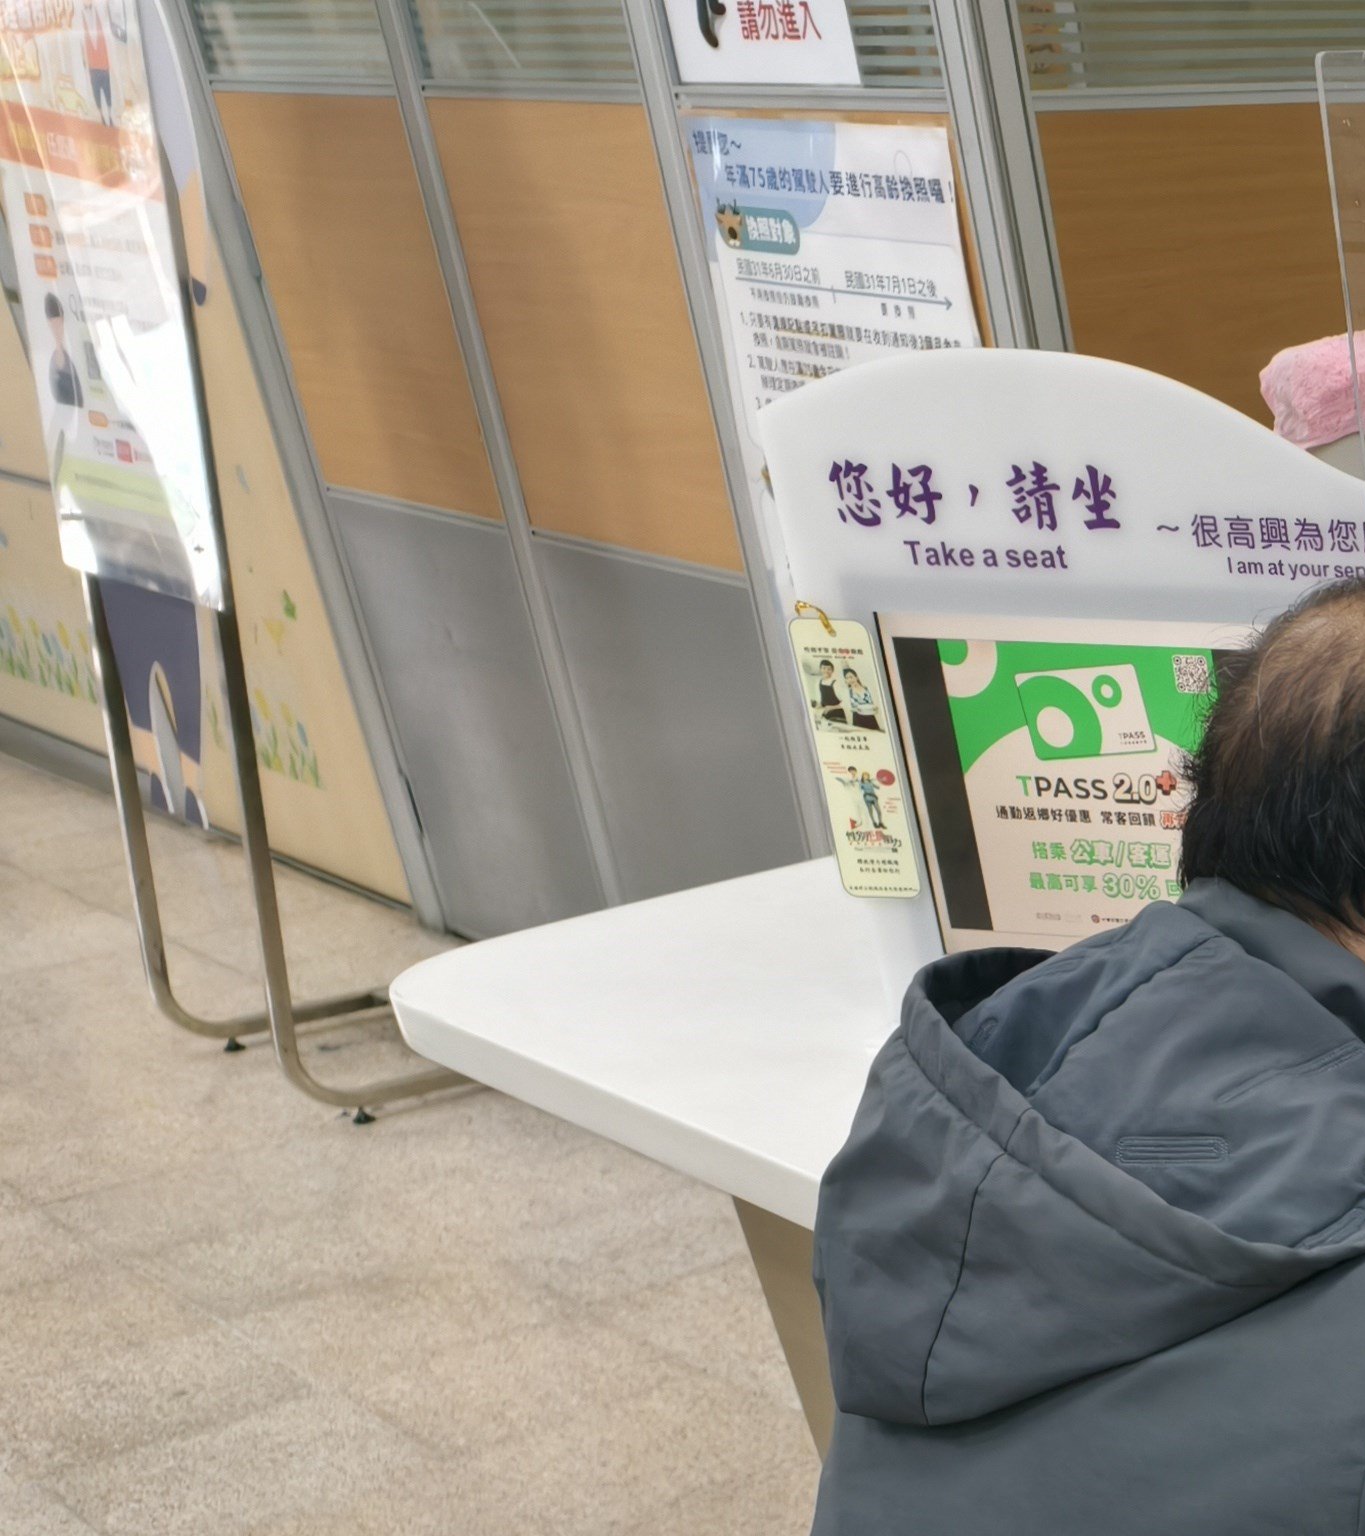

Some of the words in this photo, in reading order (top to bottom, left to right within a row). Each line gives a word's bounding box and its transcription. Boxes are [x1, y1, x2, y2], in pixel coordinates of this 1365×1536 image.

[737, 1, 822, 41] 請勿進入
[828, 459, 1121, 532] 您好，請坐
[904, 540, 974, 568] Take
[983, 547, 999, 568] a
[1005, 543, 1068, 569] seat
[1227, 557, 1233, 575] I
[1236, 561, 1262, 575] am
[1268, 559, 1284, 576] at
[1290, 562, 1329, 581] your
[1016, 775, 1108, 800] TPASS
[996, 805, 1092, 824] 通勤返鄉好優惠
[1032, 841, 1067, 861] 搭乘
[1029, 872, 1098, 892] 最高可享
[1103, 872, 1160, 900] 30%
